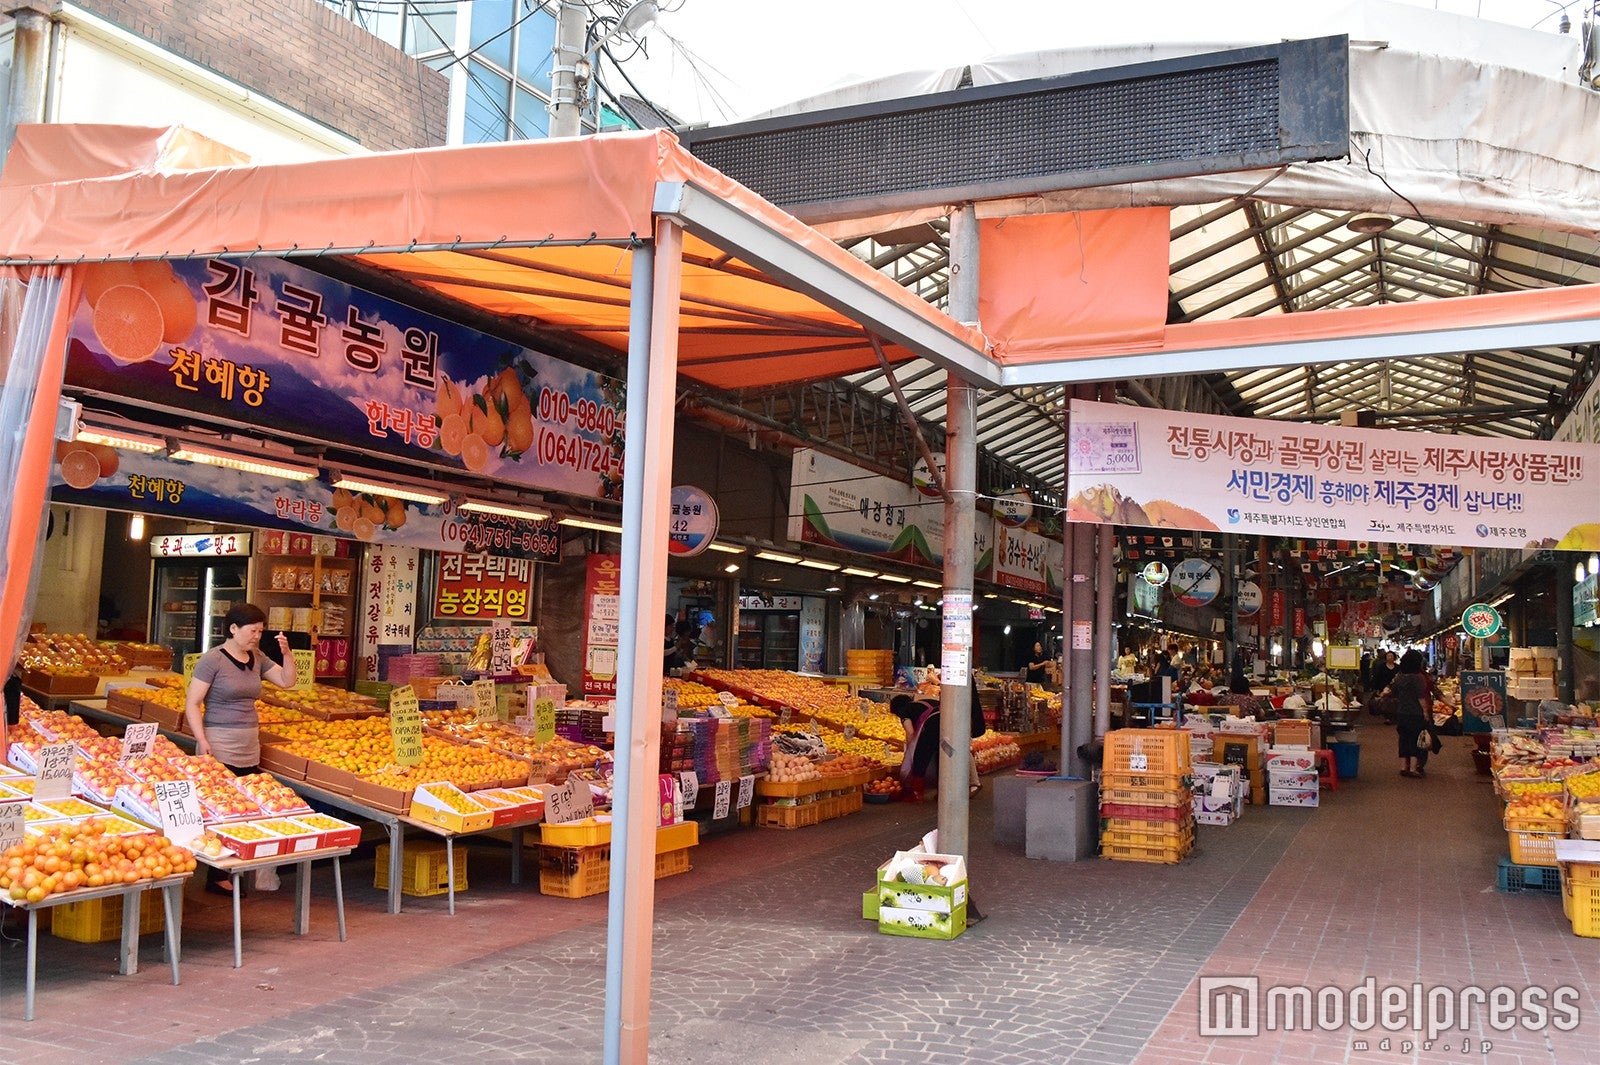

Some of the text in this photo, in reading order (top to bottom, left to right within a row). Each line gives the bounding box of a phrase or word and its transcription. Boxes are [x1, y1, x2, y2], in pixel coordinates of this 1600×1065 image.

[201, 257, 440, 391] 감귤농원
[168, 347, 272, 408] 천혜향
[364, 399, 439, 450] 한라봉
[1106, 453, 1134, 466] 5,000
[1167, 425, 1582, 483] 전통시장과 골목상권 살리는 제주사랑상품권!!
[128, 474, 185, 505] 천혜향
[1226, 469, 1523, 513] 서민경제 흥해야 제주경제 삽니다!!
[273, 496, 324, 524] 한라봉
[1243, 511, 1347, 531] 제주특별자치도 상인연합회
[441, 519, 558, 554] (064)751-5654
[672, 520, 689, 532] 42
[1369, 519, 1392, 532] Jeju
[1396, 522, 1457, 535] 제주특별자치도
[1489, 526, 1528, 538] 제주은행
[214, 536, 237, 555] 망고
[442, 552, 532, 584] 전국택배
[438, 588, 528, 617] 농장직영
[1464, 675, 1503, 687] 오메기
[1469, 691, 1496, 715] 떡
[155, 781, 191, 802] 황금향
